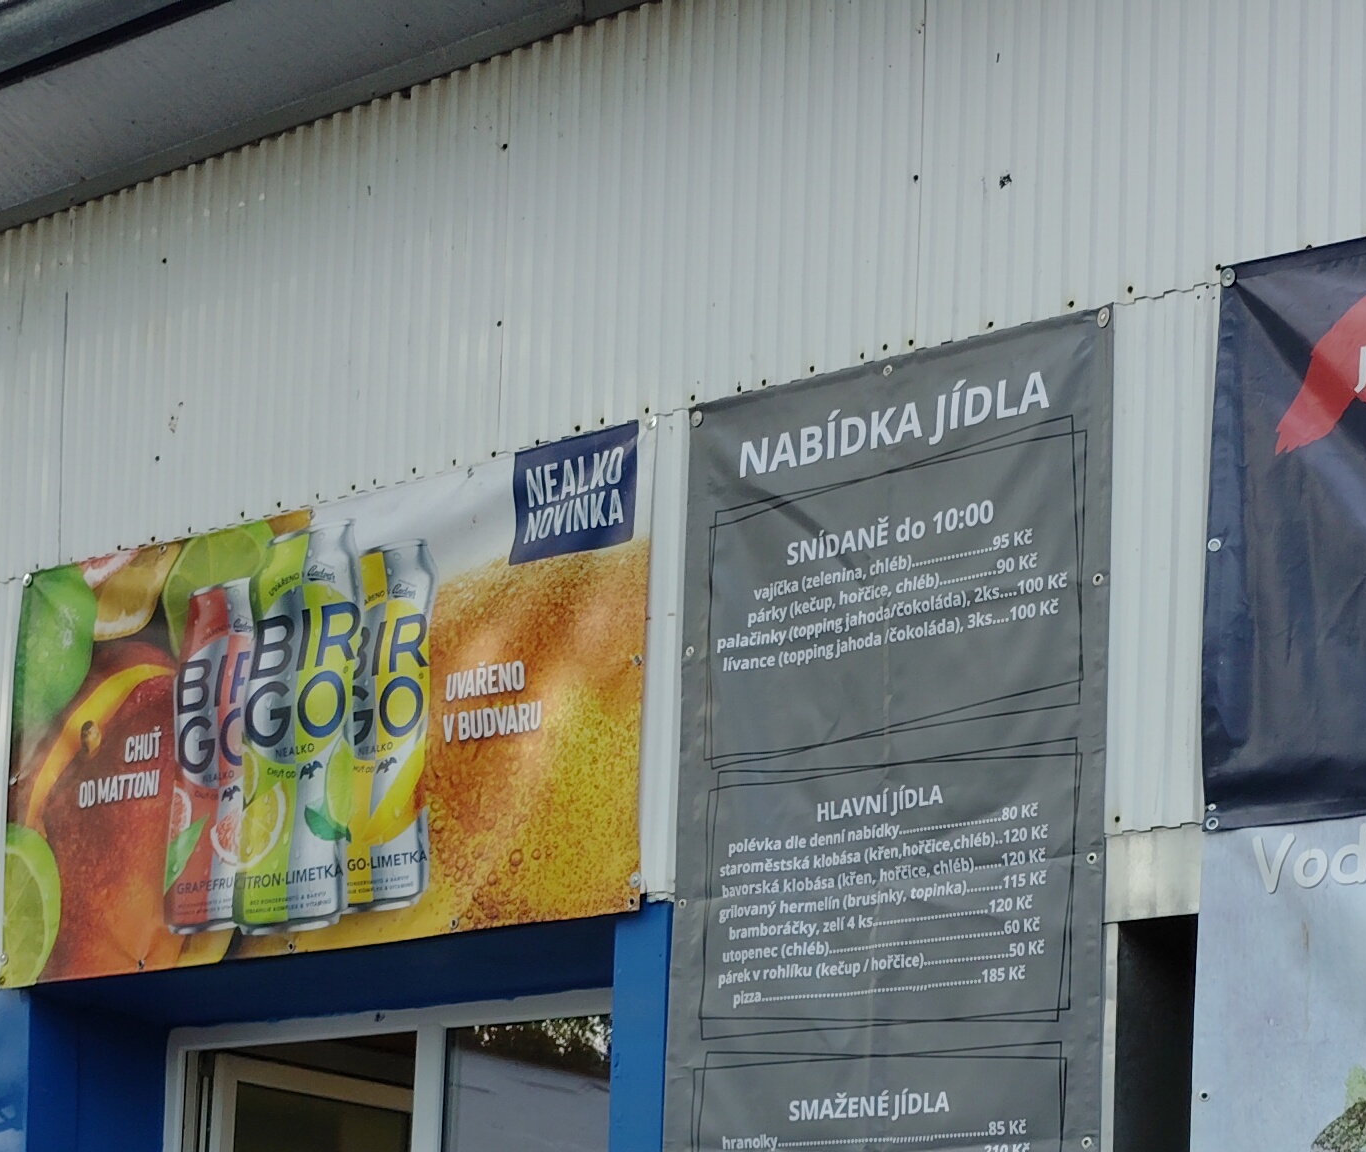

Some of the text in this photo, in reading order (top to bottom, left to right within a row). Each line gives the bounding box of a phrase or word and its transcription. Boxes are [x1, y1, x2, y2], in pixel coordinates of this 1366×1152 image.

[739, 371, 1050, 478] NABÍDKA JÍDLA
[525, 445, 626, 508] NEALKO
[523, 486, 626, 545] NOVINKA
[786, 500, 994, 566] SNÍDANĚ do 10:00
[753, 577, 799, 601] vajíčka
[801, 565, 867, 593] (zelenina,
[1012, 528, 1034, 546] Kč
[249, 601, 361, 682] BIR
[445, 660, 525, 701] UVAŘENO
[245, 670, 347, 748] GO
[443, 701, 542, 743] V BUDVARU
[124, 727, 162, 765] CHUŤ
[274, 742, 315, 759] NEALKO
[78, 770, 160, 809] OD MATTONI
[816, 784, 944, 822] HLAVNÍ JÍDLA
[728, 835, 782, 856] polévka
[785, 834, 807, 849] dle
[809, 830, 845, 848] denní
[1021, 802, 1039, 818] Kč
[718, 901, 776, 924] grilovaný
[779, 895, 840, 914] hermelín
[843, 888, 907, 911] (brusinky,
[1030, 870, 1047, 885] Kč
[789, 1088, 950, 1122] SMAŽENÉ JÍDLA
